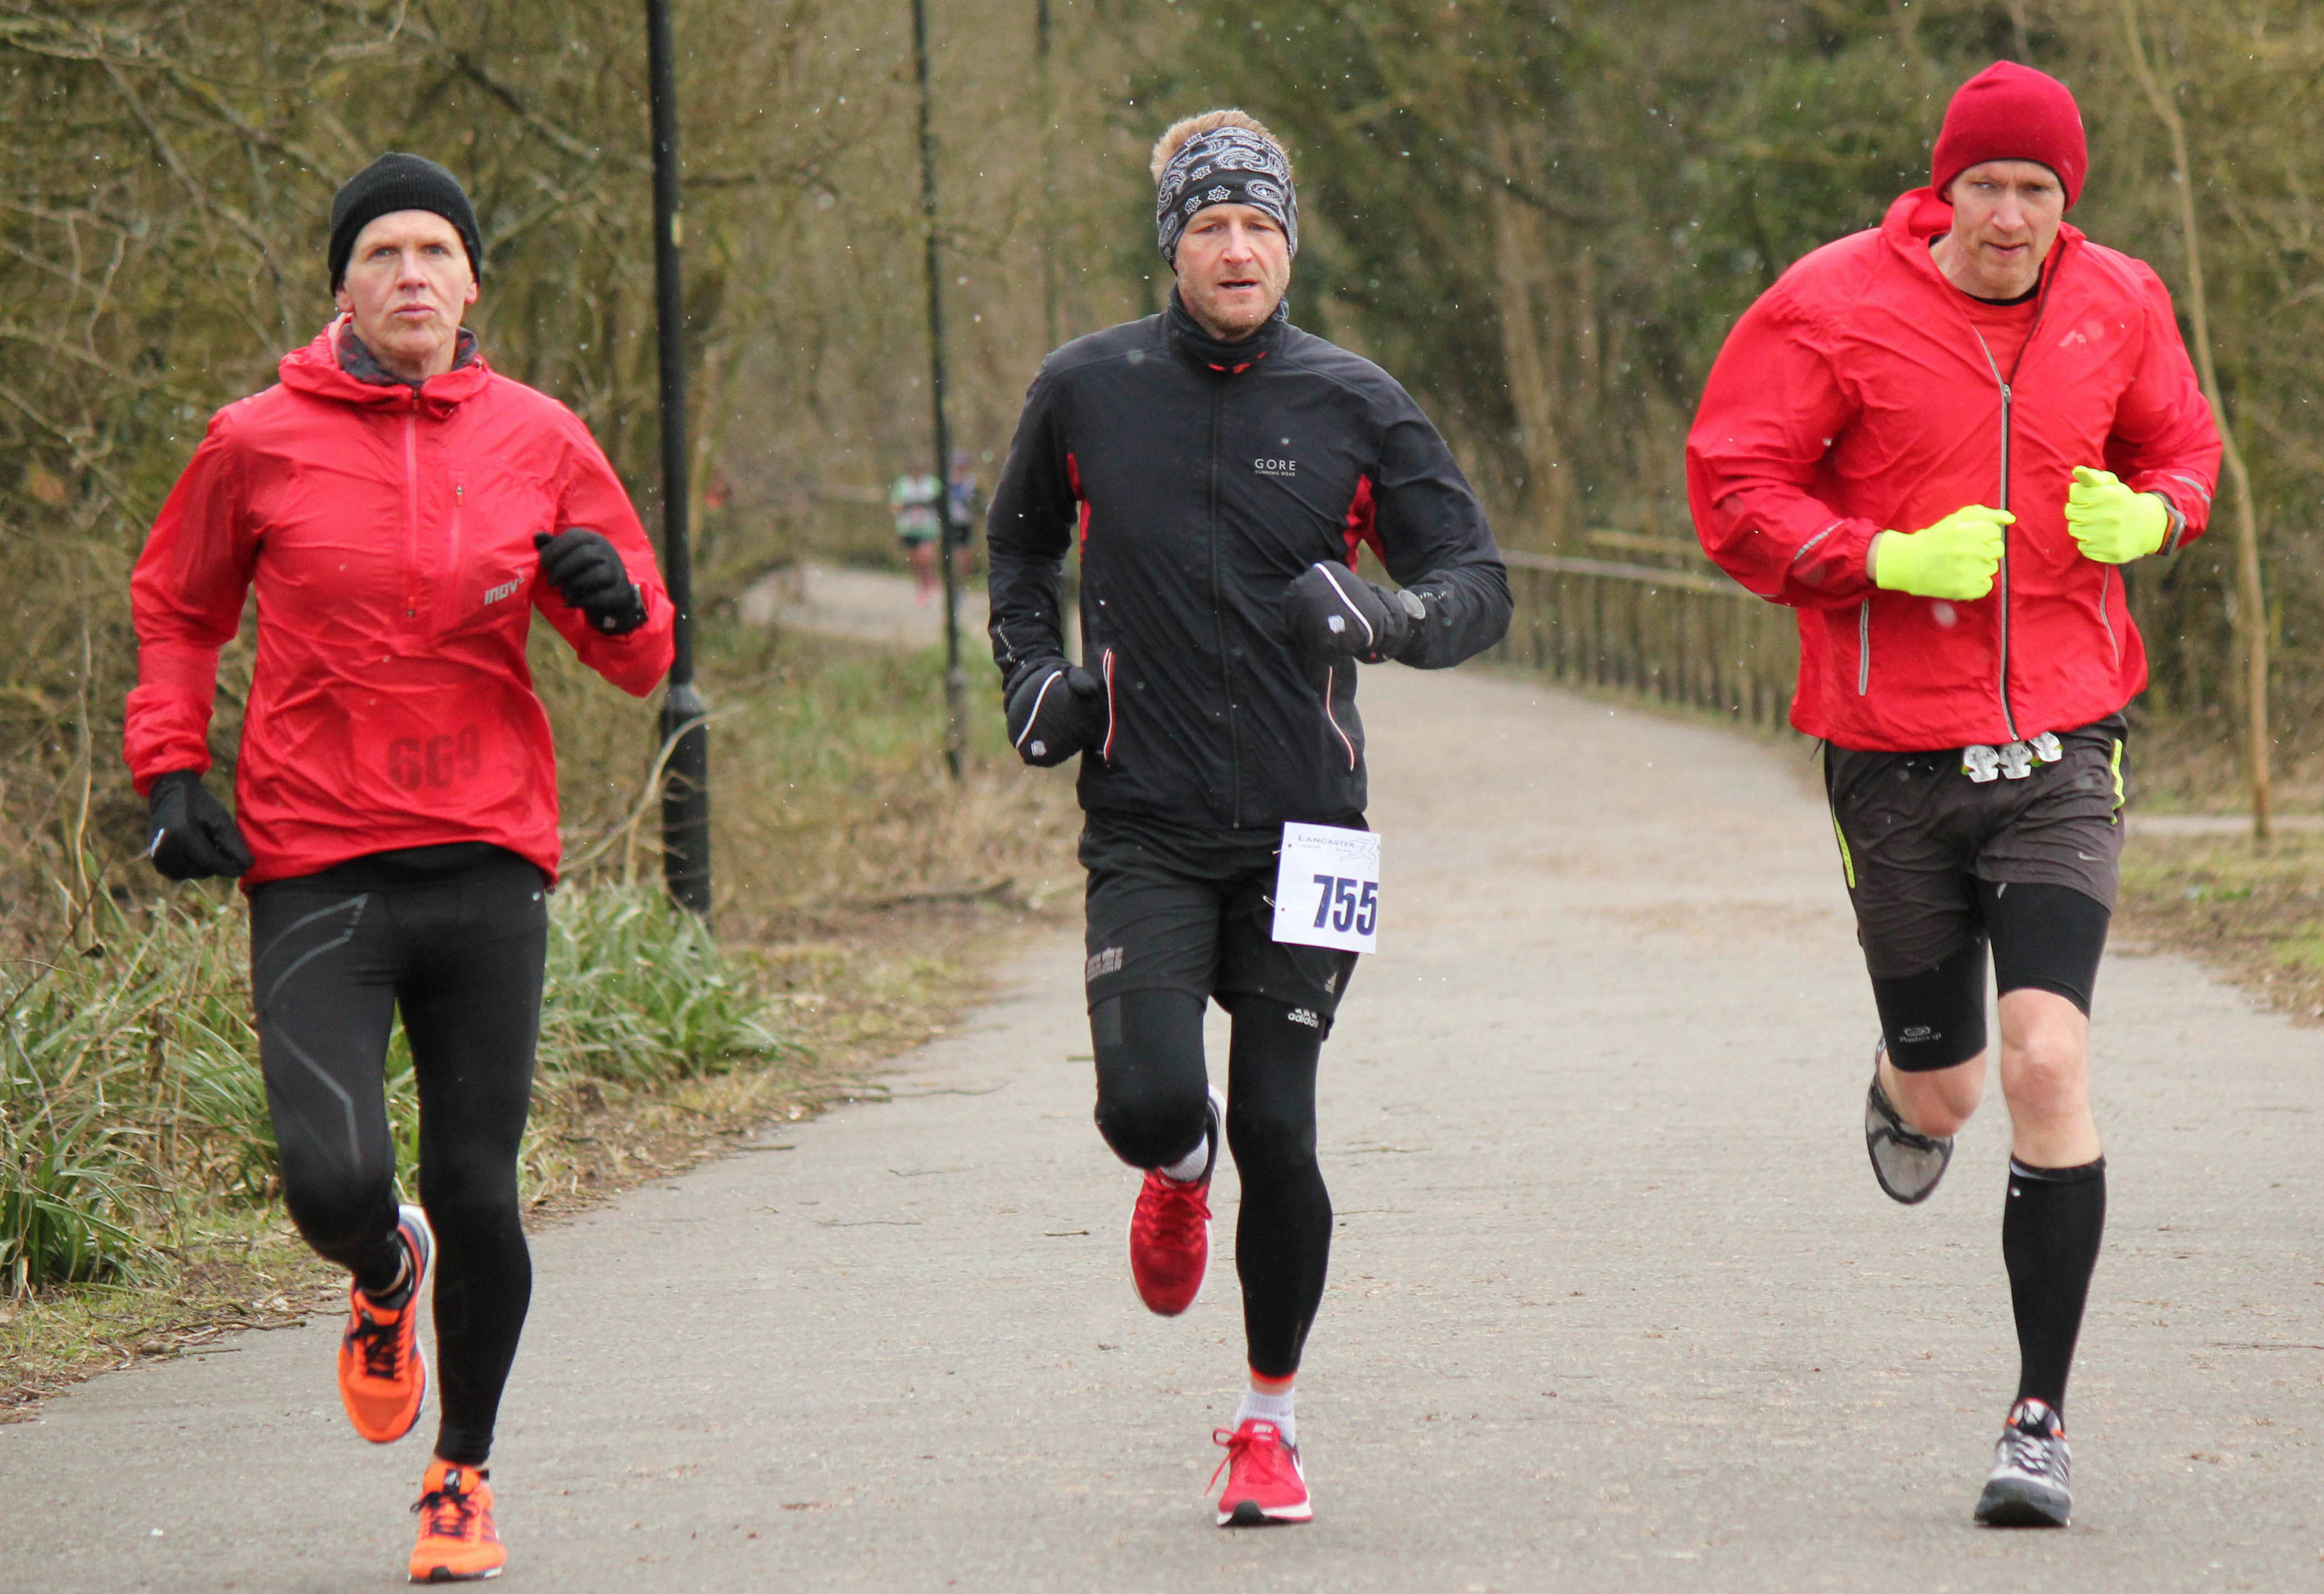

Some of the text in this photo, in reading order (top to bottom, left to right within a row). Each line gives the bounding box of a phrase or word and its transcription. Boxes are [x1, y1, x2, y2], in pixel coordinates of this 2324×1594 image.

[1255, 458, 1296, 471] GORE
[1298, 835, 1355, 848] LANCASTER
[1313, 874, 1379, 936] 755
[1287, 1012, 1319, 1028] adidas
